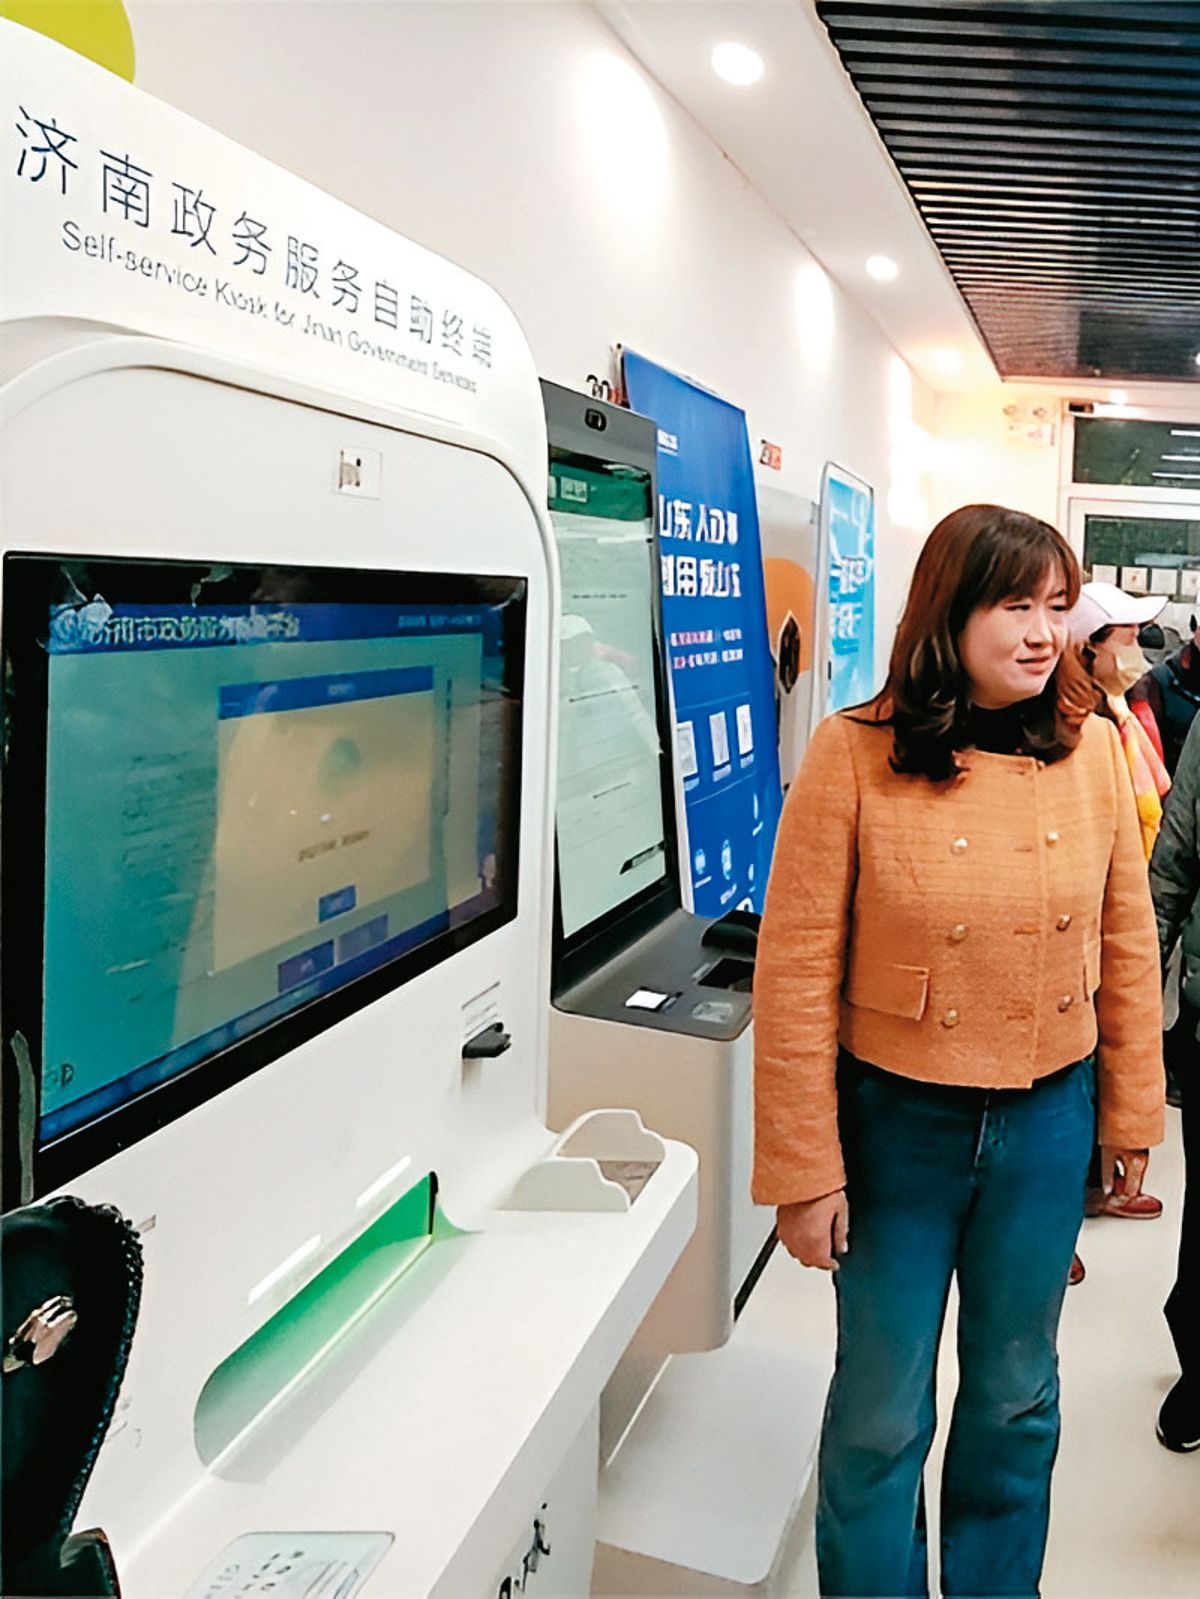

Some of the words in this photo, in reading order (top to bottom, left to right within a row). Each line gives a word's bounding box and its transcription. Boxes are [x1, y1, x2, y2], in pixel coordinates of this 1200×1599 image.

[16, 105, 492, 368] 济南政务服务自助终端
[62, 220, 207, 296] Self-service
